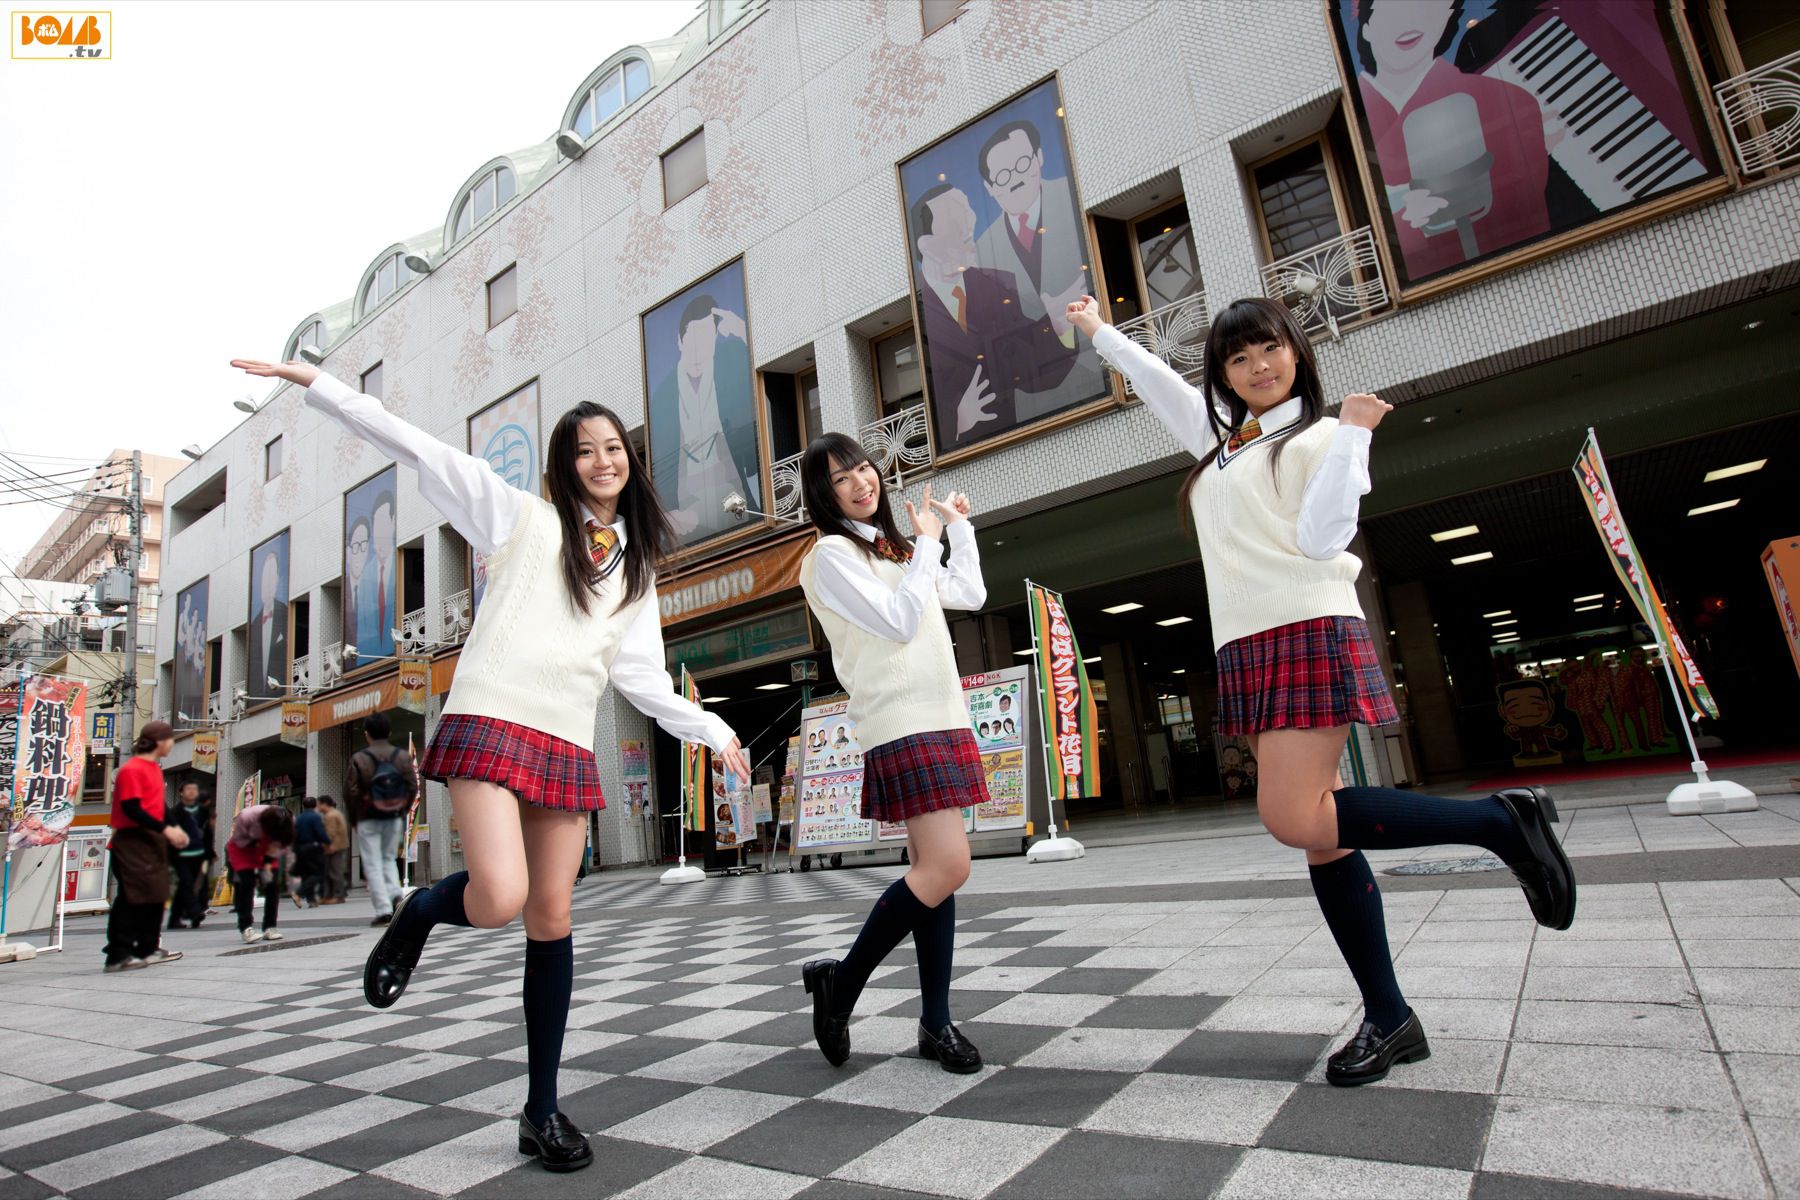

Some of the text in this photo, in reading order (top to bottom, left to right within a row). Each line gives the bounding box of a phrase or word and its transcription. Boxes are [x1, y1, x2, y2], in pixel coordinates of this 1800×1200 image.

[970, 693, 985, 703] 吉本
[1047, 601, 1082, 777] なんばグランド花月
[333, 690, 382, 720] YOSHIMOTO
[970, 700, 993, 712] 新喜劇
[95, 716, 109, 738] 古川
[25, 697, 71, 811] 鍋料理
